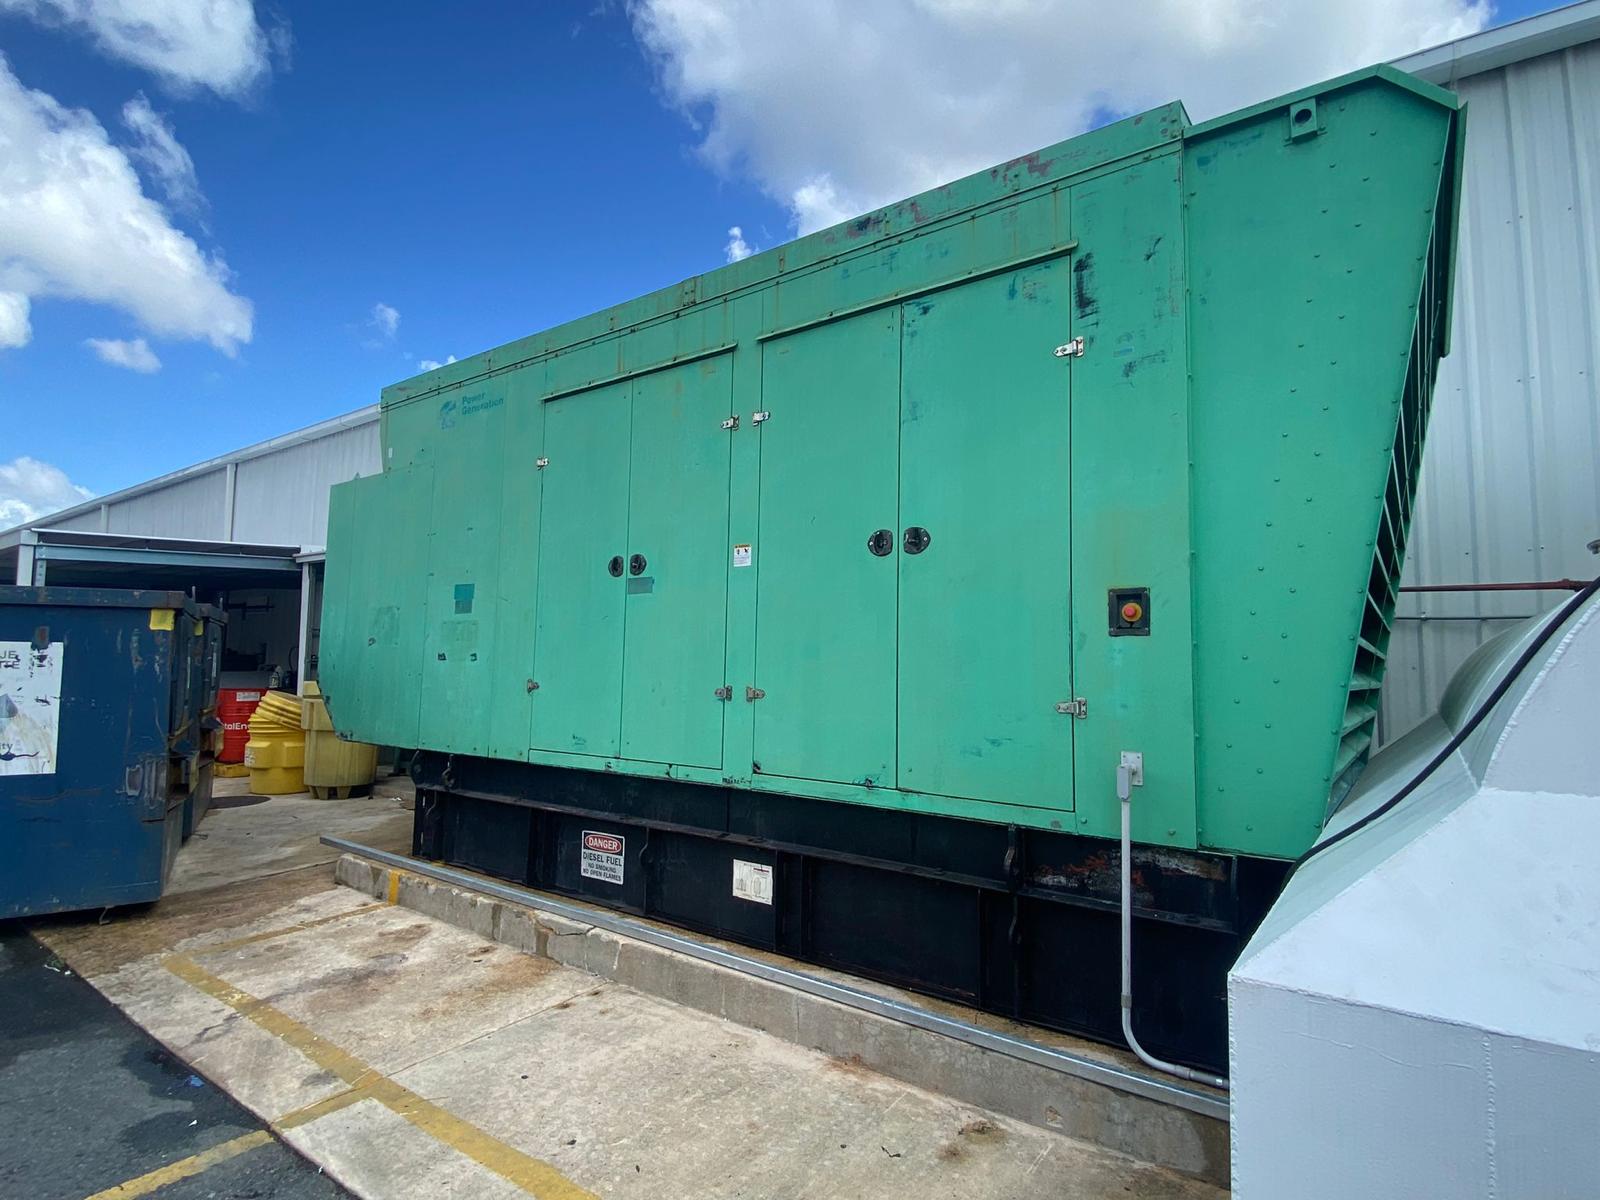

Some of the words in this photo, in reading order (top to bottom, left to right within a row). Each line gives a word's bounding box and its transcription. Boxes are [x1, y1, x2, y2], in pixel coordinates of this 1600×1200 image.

[462, 392, 485, 404] Power
[462, 398, 503, 415] Generation
[588, 837, 617, 850] DANGER
[583, 852, 604, 862] DIESEL
[606, 856, 622, 866] FUEL
[595, 864, 616, 873] SMOKING
[590, 869, 602, 877] OPEN
[603, 872, 621, 881] FLAMES
